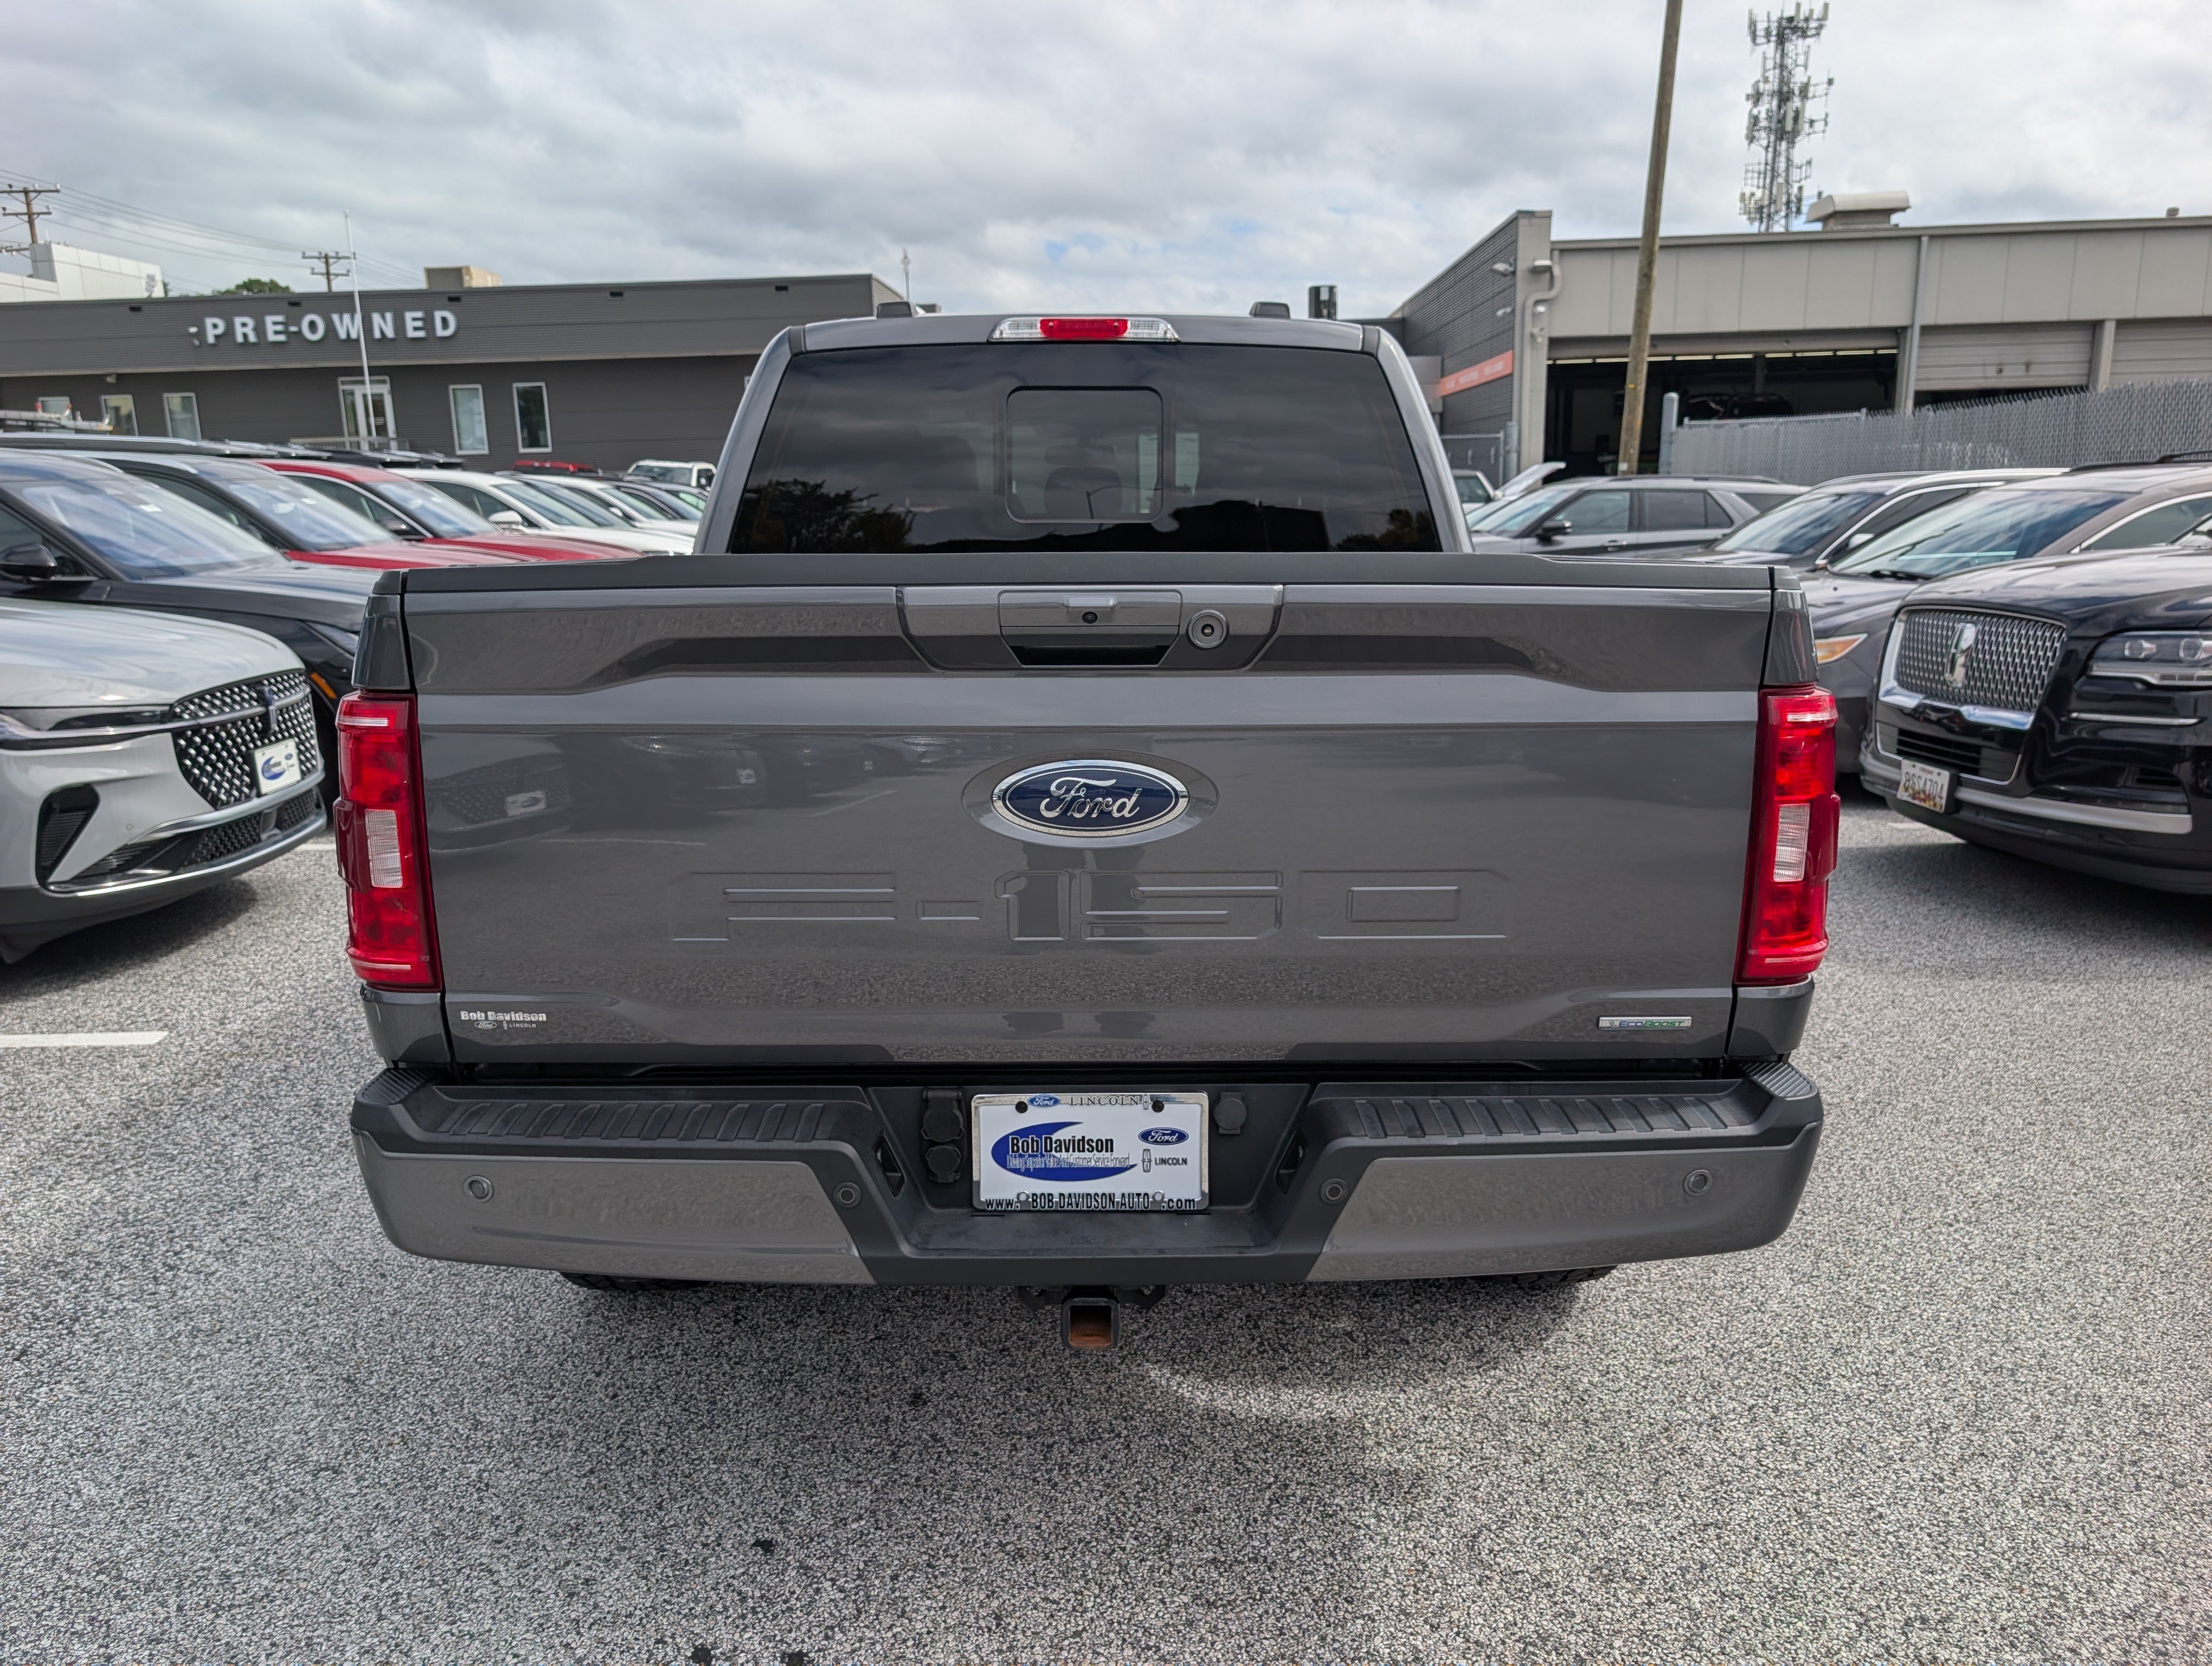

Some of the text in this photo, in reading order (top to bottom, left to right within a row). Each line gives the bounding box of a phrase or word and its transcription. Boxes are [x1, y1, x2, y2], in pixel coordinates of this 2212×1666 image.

[204, 310, 458, 344] PRE-OWNED
[1039, 776, 1143, 818] Ford
[668, 870, 1513, 941] F-150
[460, 1011, 547, 1021] Bob Davidson
[1070, 1096, 1139, 1106] LINCOLN
[1148, 1130, 1179, 1142] Ford
[1011, 1136, 1114, 1154] Bob Davidson
[1070, 1153, 1092, 1167] Customer
[1092, 1153, 1110, 1167] Service
[1110, 1152, 1130, 1167] Forward
[1154, 1157, 1188, 1165] LINCOLN
[986, 1199, 1020, 1209] www.
[1032, 1193, 1054, 1209] BOB
[1059, 1193, 1115, 1209] DAVIDSON
[1120, 1193, 1149, 1209] AUTO
